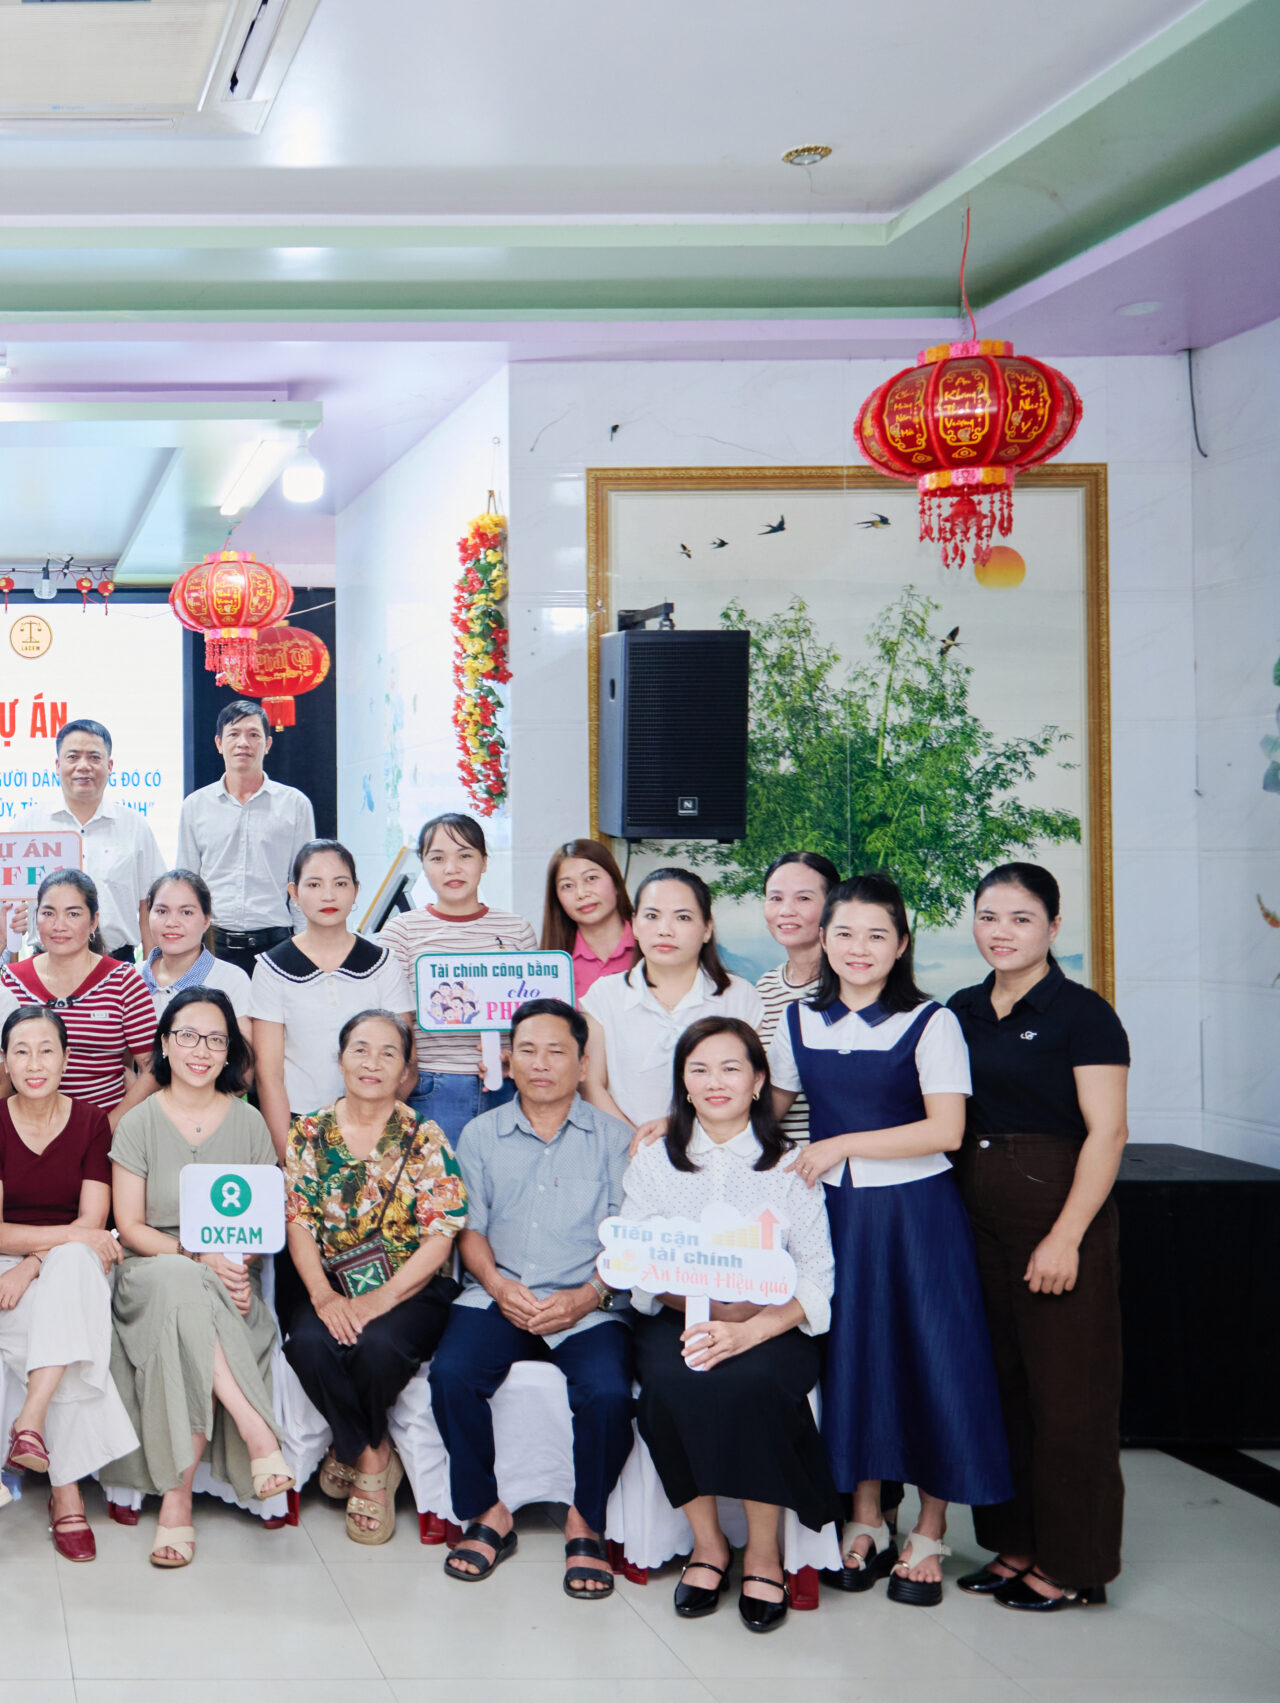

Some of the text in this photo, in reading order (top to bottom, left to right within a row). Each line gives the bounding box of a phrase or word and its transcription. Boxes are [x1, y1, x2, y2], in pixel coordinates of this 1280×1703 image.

[30, 692, 68, 739] ÁN
[32, 769, 61, 788] DÂN
[145, 769, 162, 788] CÓ
[22, 838, 62, 858] ÁN
[429, 960, 559, 979] Tài chính công bằng
[507, 980, 541, 999] cho
[201, 1226, 263, 1245] OXFAM
[610, 1222, 700, 1249] Tiếp cận
[649, 1246, 743, 1269] tài chính
[641, 1263, 670, 1281] An
[714, 1271, 754, 1296] Hiệu
